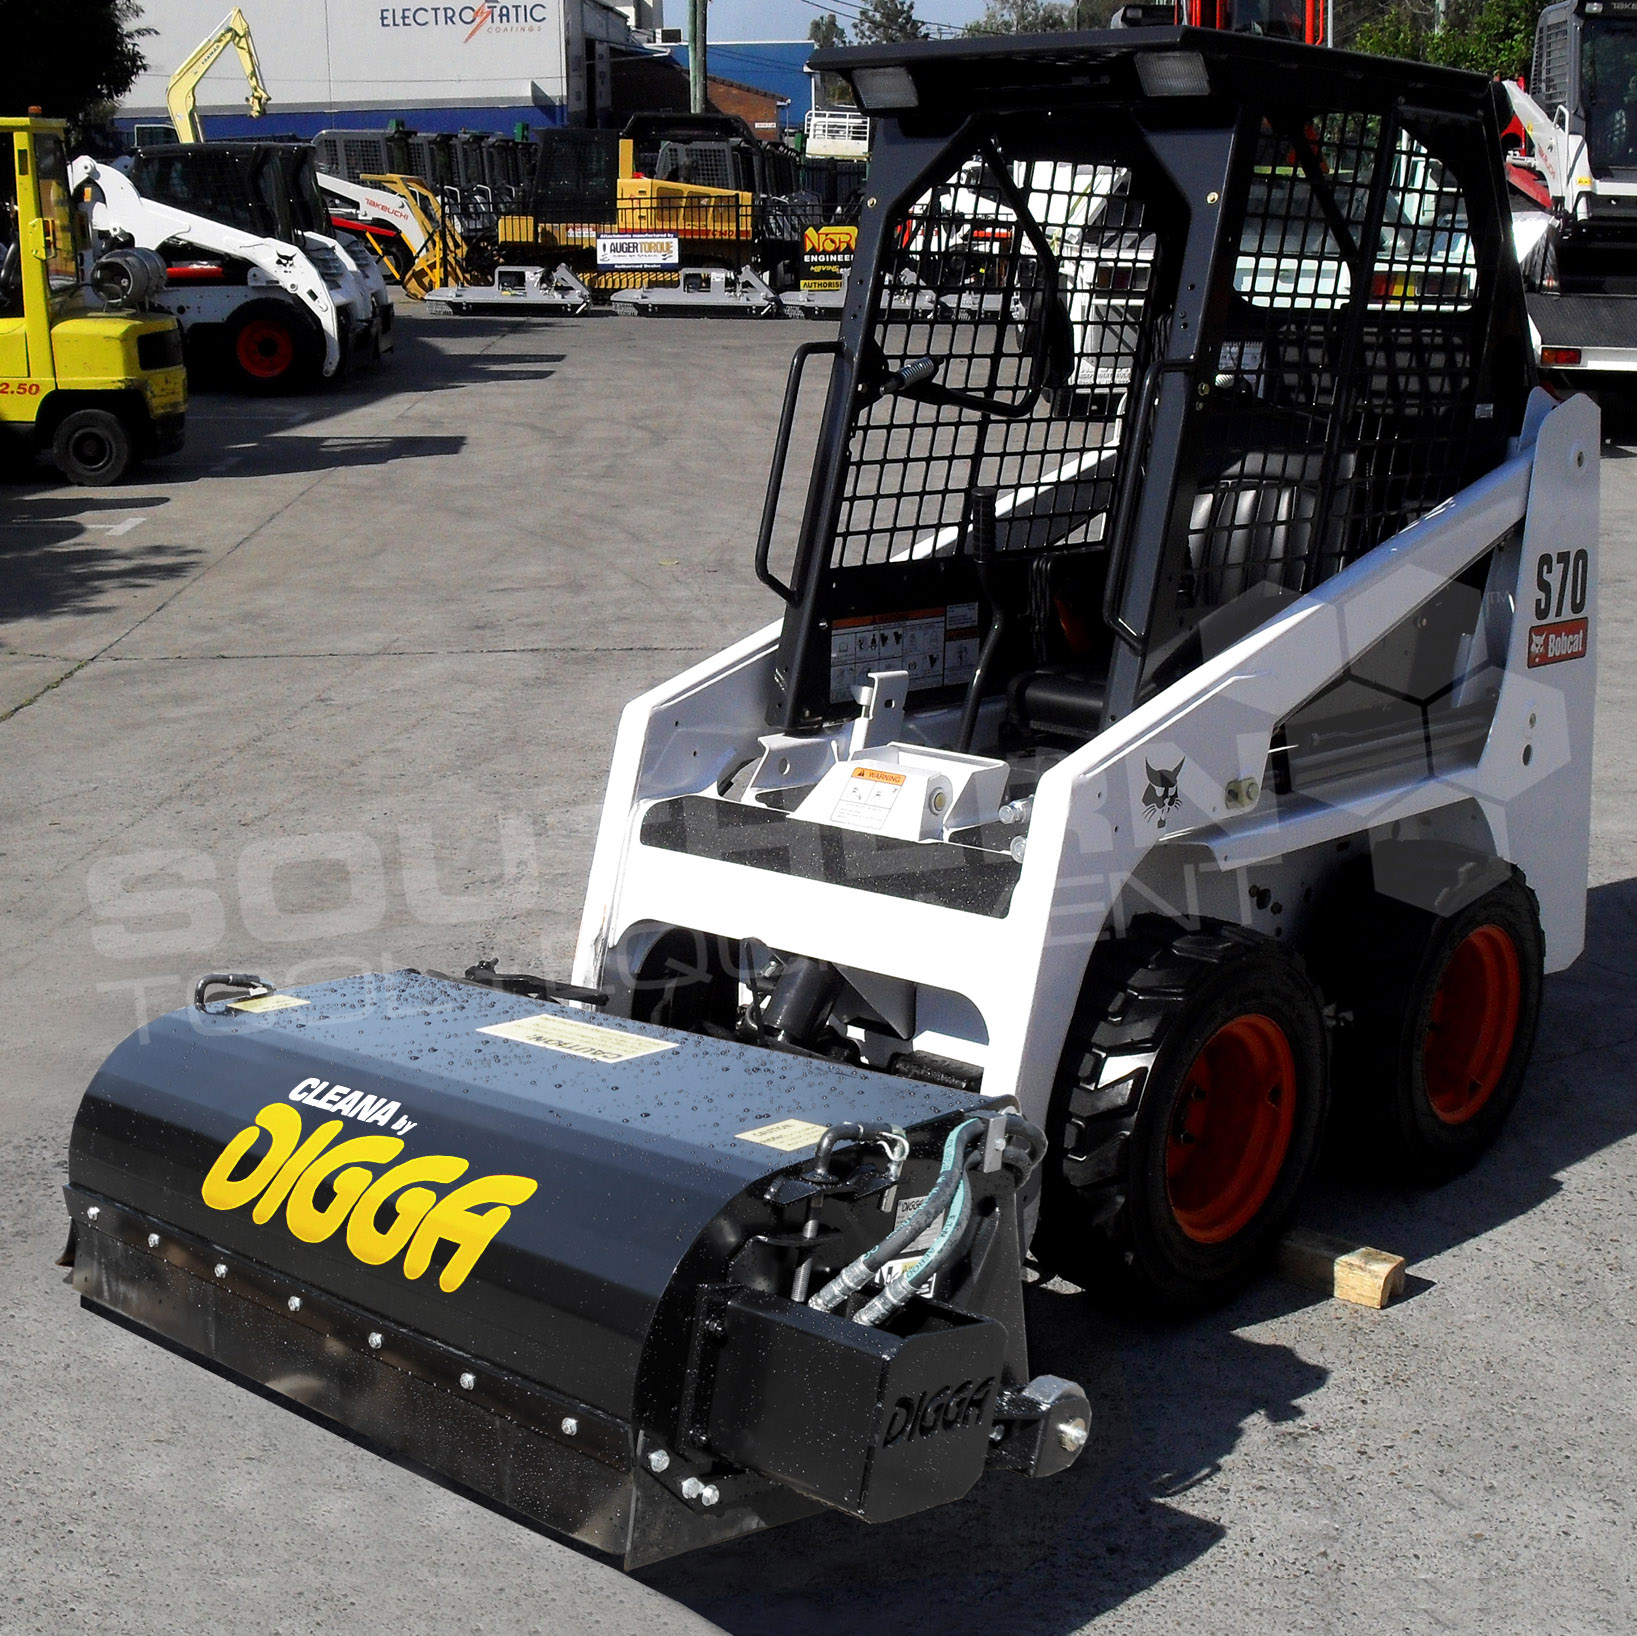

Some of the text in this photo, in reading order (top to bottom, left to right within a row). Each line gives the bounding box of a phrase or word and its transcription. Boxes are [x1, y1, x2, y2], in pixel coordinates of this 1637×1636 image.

[804, 226, 858, 253] NOR
[1535, 548, 1588, 621] S70
[1547, 629, 1583, 658] Bobcat
[868, 771, 902, 783] WARNING
[288, 1076, 418, 1136] CLEANA by
[201, 1102, 539, 1294] DIGGA
[882, 1375, 996, 1450] DIGGA
